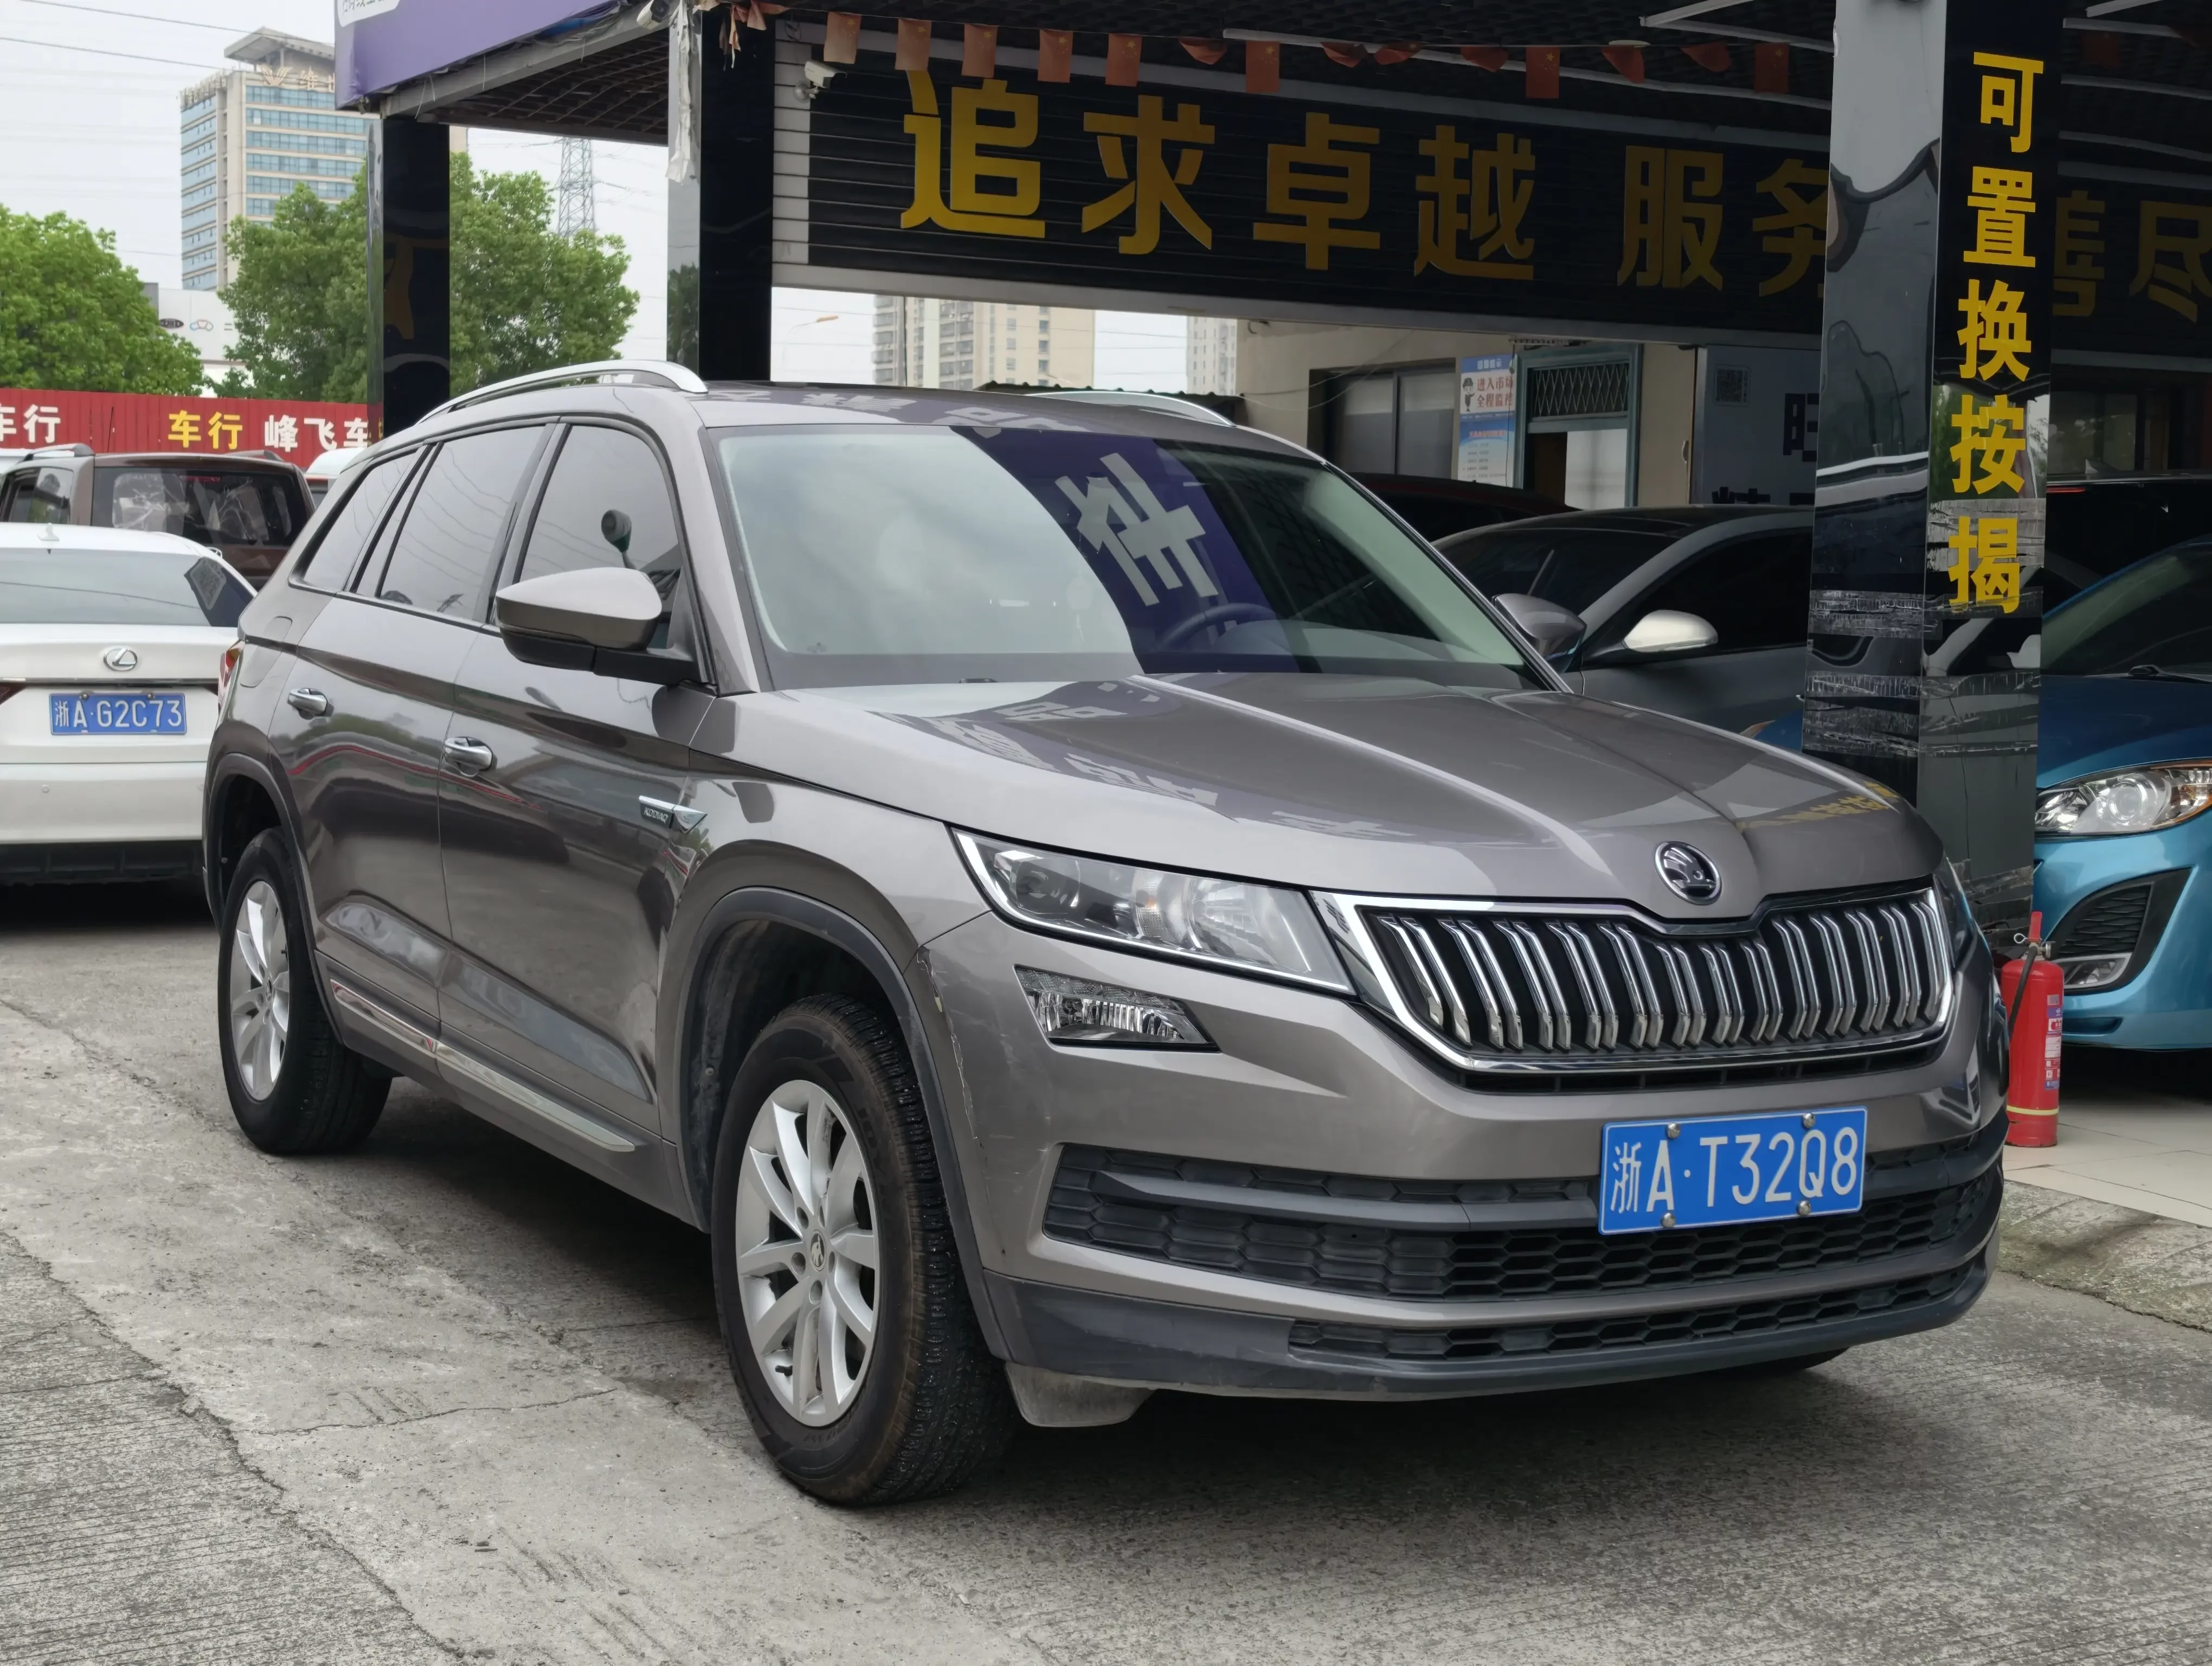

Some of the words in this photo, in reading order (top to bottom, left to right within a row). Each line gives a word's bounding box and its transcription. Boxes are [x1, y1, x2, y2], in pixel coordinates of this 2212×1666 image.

[901, 69, 1535, 280] 追求卓越
[168, 410, 243, 450] 车行
[1948, 52, 2044, 614] 可置换按揭
